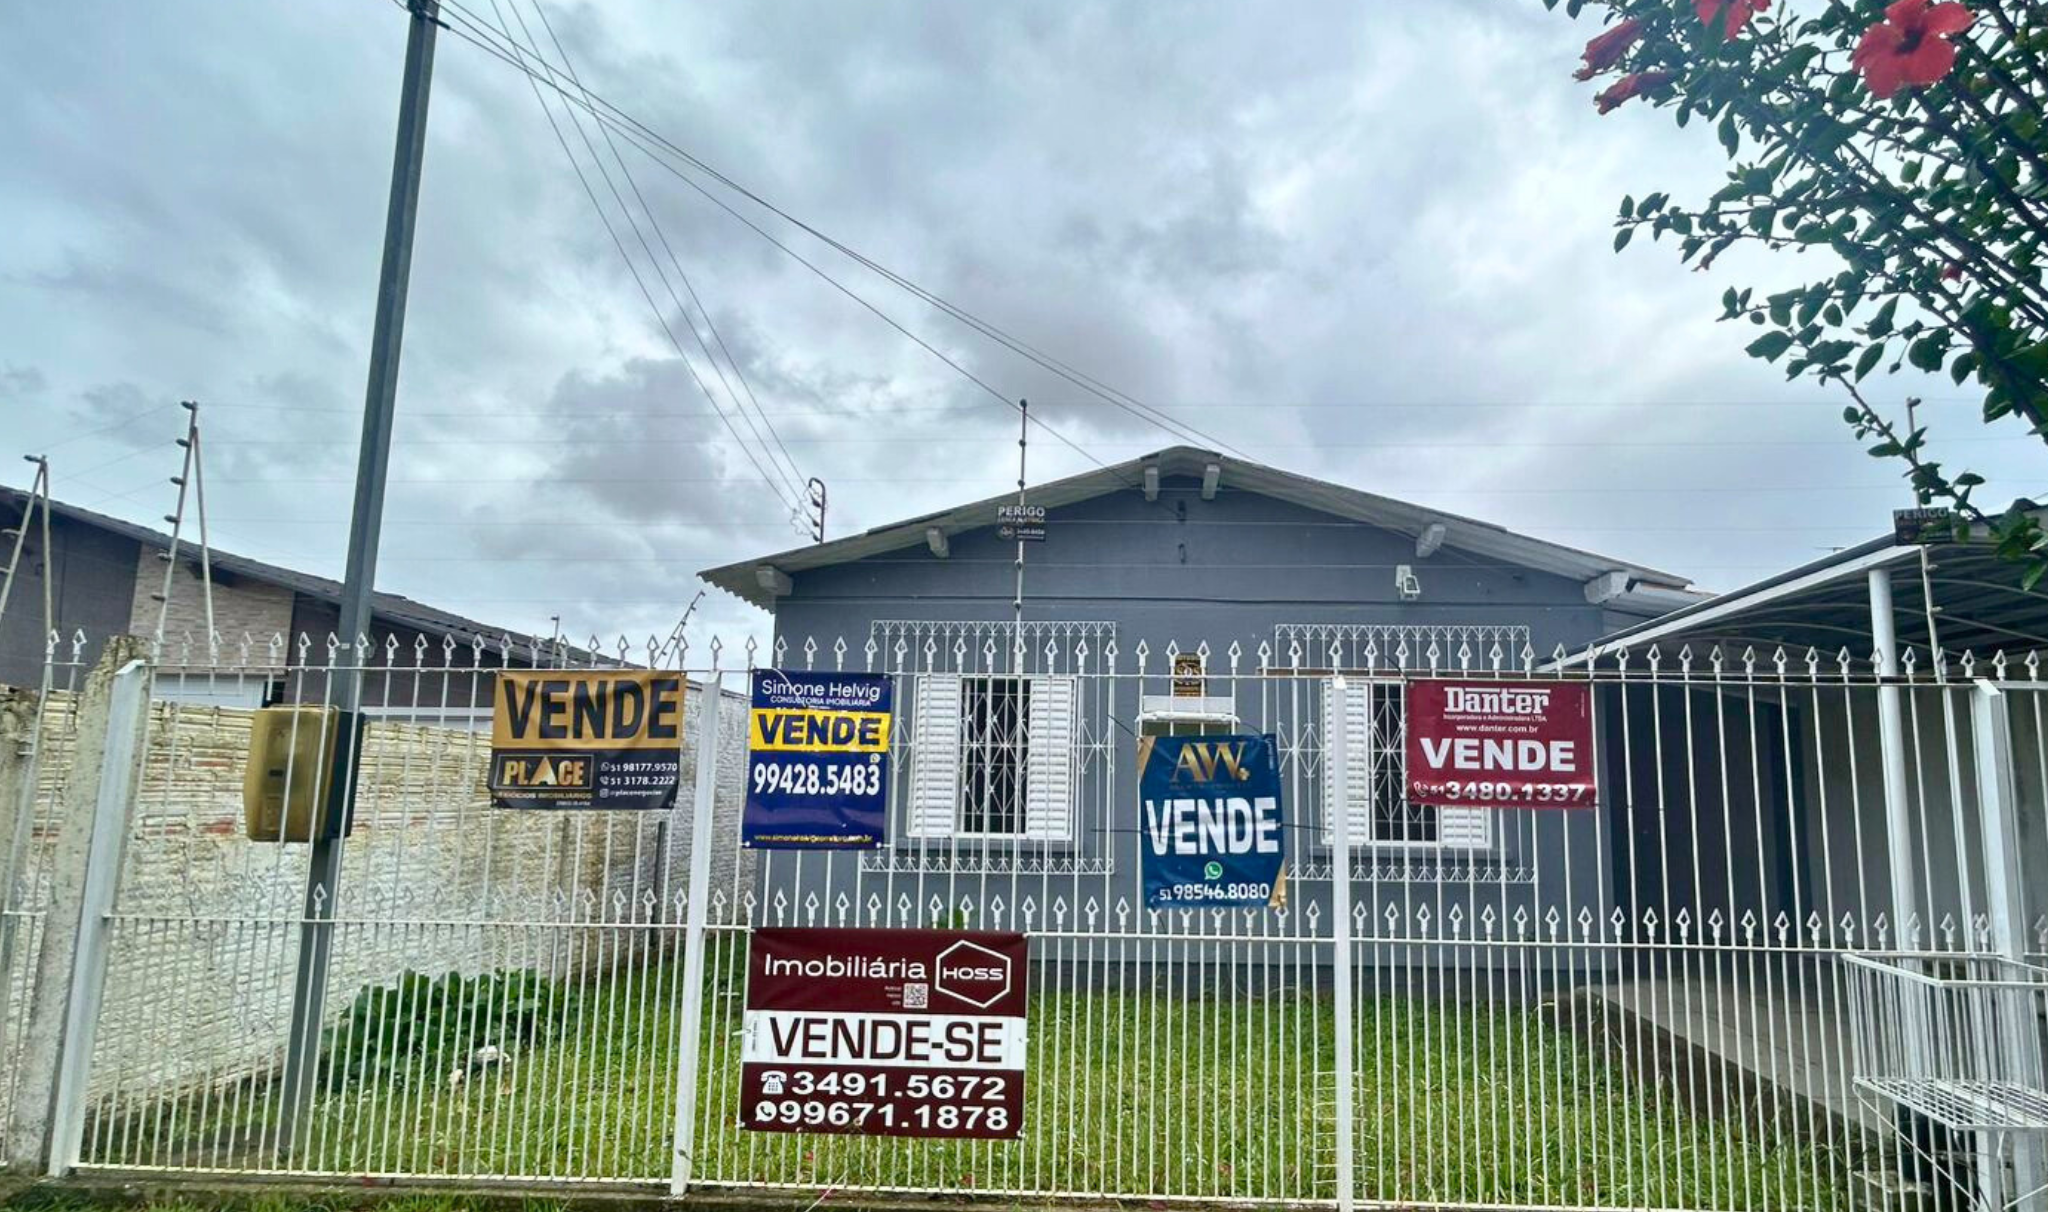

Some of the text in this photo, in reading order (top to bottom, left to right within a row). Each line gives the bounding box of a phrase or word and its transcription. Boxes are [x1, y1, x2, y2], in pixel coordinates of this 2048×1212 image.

[998, 506, 1046, 517] PERIGO
[1894, 508, 1947, 519] PERIGO
[762, 679, 881, 702] Simone Helvig
[1443, 687, 1551, 714] Danter
[503, 679, 679, 739] VENDE
[758, 714, 882, 746] VENDE
[1456, 724, 1539, 733] www.danter.com.br
[610, 762, 678, 772] 51 98177.9570
[1419, 738, 1576, 772] VENDE
[503, 756, 584, 786] PLACE
[610, 776, 675, 786] 51 3178.2222
[754, 763, 880, 796] 99428.5483
[1445, 781, 1586, 801] 3480.1337
[1145, 797, 1279, 856] VENDE
[1160, 883, 1270, 900] 51 98546.8080
[764, 953, 1004, 981] Imobiliária HOSS
[769, 1017, 1004, 1063] VENDE-SE
[791, 1071, 1006, 1101] 3491.5672
[778, 1101, 1009, 1131] 99671.1878
